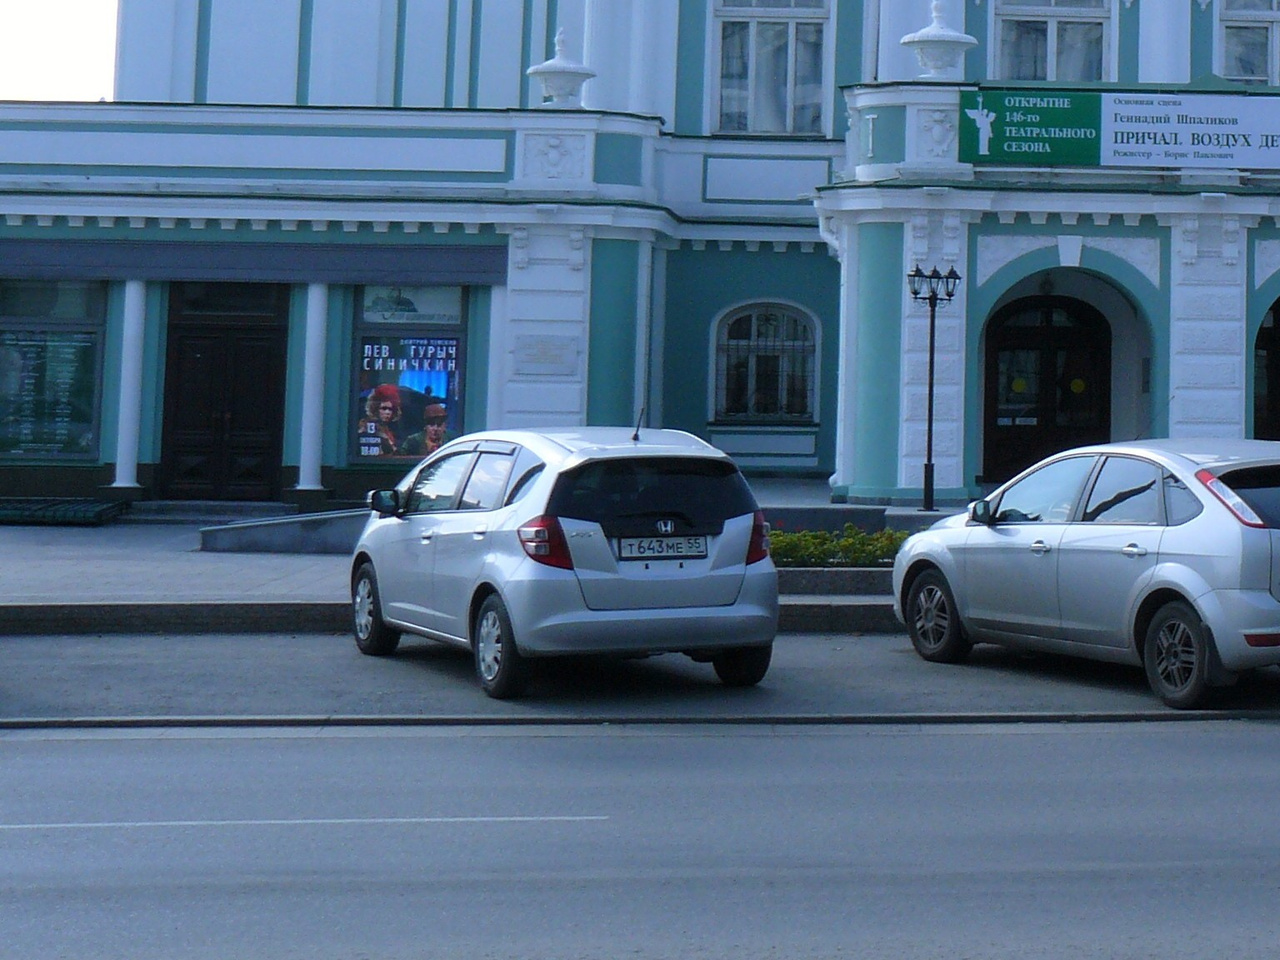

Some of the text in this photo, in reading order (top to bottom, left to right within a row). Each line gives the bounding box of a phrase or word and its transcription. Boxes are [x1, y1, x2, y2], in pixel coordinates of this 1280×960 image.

[1004, 97, 1072, 108] ОТКРЫТИЕ
[1113, 97, 1182, 108] Основная сцена
[1005, 111, 1040, 123] 146-го
[1113, 112, 1239, 126] Геннадий Шпаликов
[1004, 126, 1096, 139] ТЕАТРАЛЬНОГО
[1113, 131, 1183, 146] ПРИЧАЛ.
[1191, 133, 1252, 149] ВОЗДУХ
[1003, 142, 1051, 153] СЕЗОНА
[1113, 150, 1152, 160] Режиссер
[1164, 150, 1189, 161] Борис
[363, 345, 456, 359] ЛЕВ ГУРЫЧ
[363, 358, 456, 372] СИНИЧКИН
